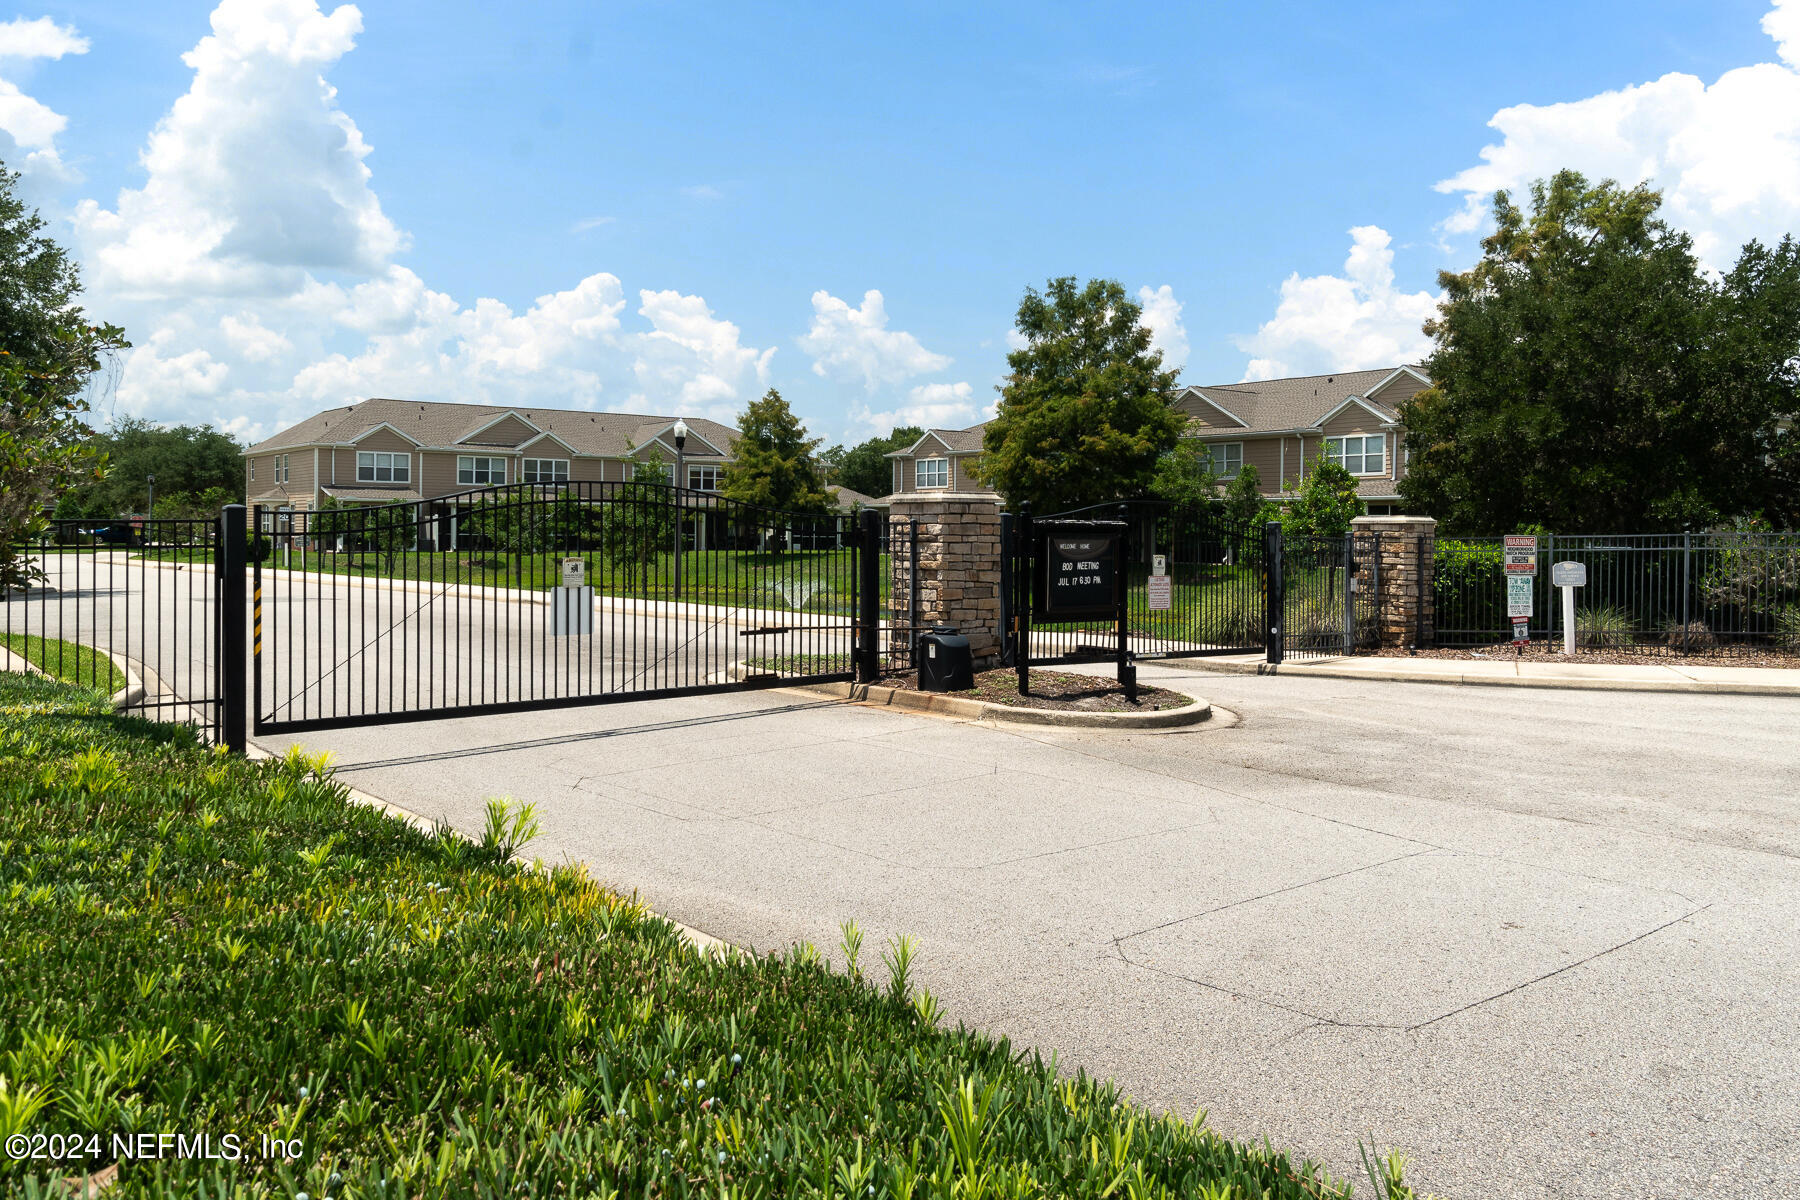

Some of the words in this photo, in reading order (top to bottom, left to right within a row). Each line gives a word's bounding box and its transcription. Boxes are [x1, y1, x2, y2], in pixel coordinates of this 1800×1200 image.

[1507, 538, 1534, 546] WARNING
[1062, 562, 1073, 571] BOD
[1077, 561, 1100, 570] MEETING
[1058, 577, 1070, 586] JUL
[1072, 577, 1078, 586] 17
